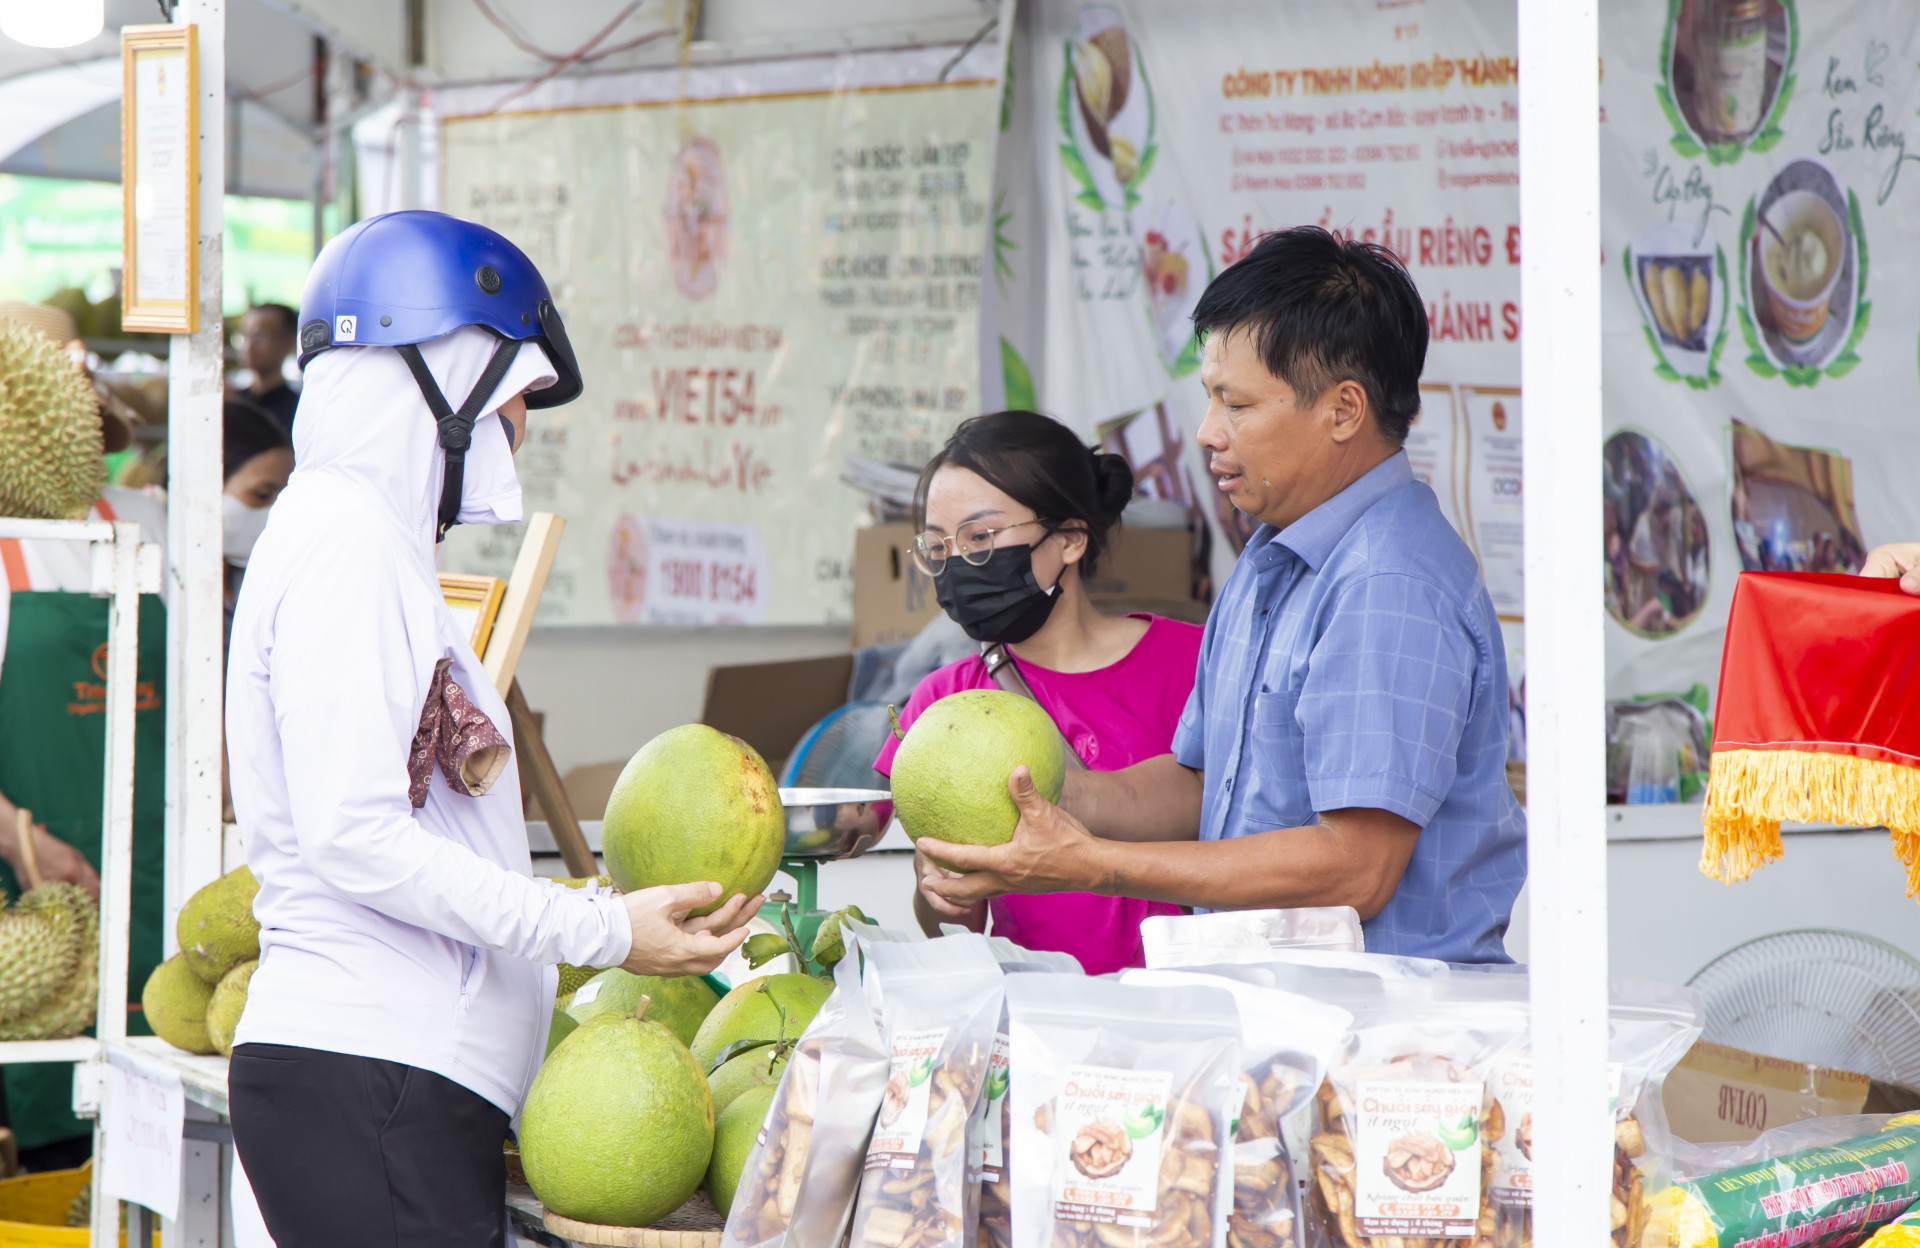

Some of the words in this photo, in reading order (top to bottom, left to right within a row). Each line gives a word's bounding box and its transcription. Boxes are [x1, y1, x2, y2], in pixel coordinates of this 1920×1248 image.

[1363, 1094, 1411, 1113] Chuối
[1414, 1095, 1441, 1119] sấy
[1719, 1084, 1767, 1131] COTAB
